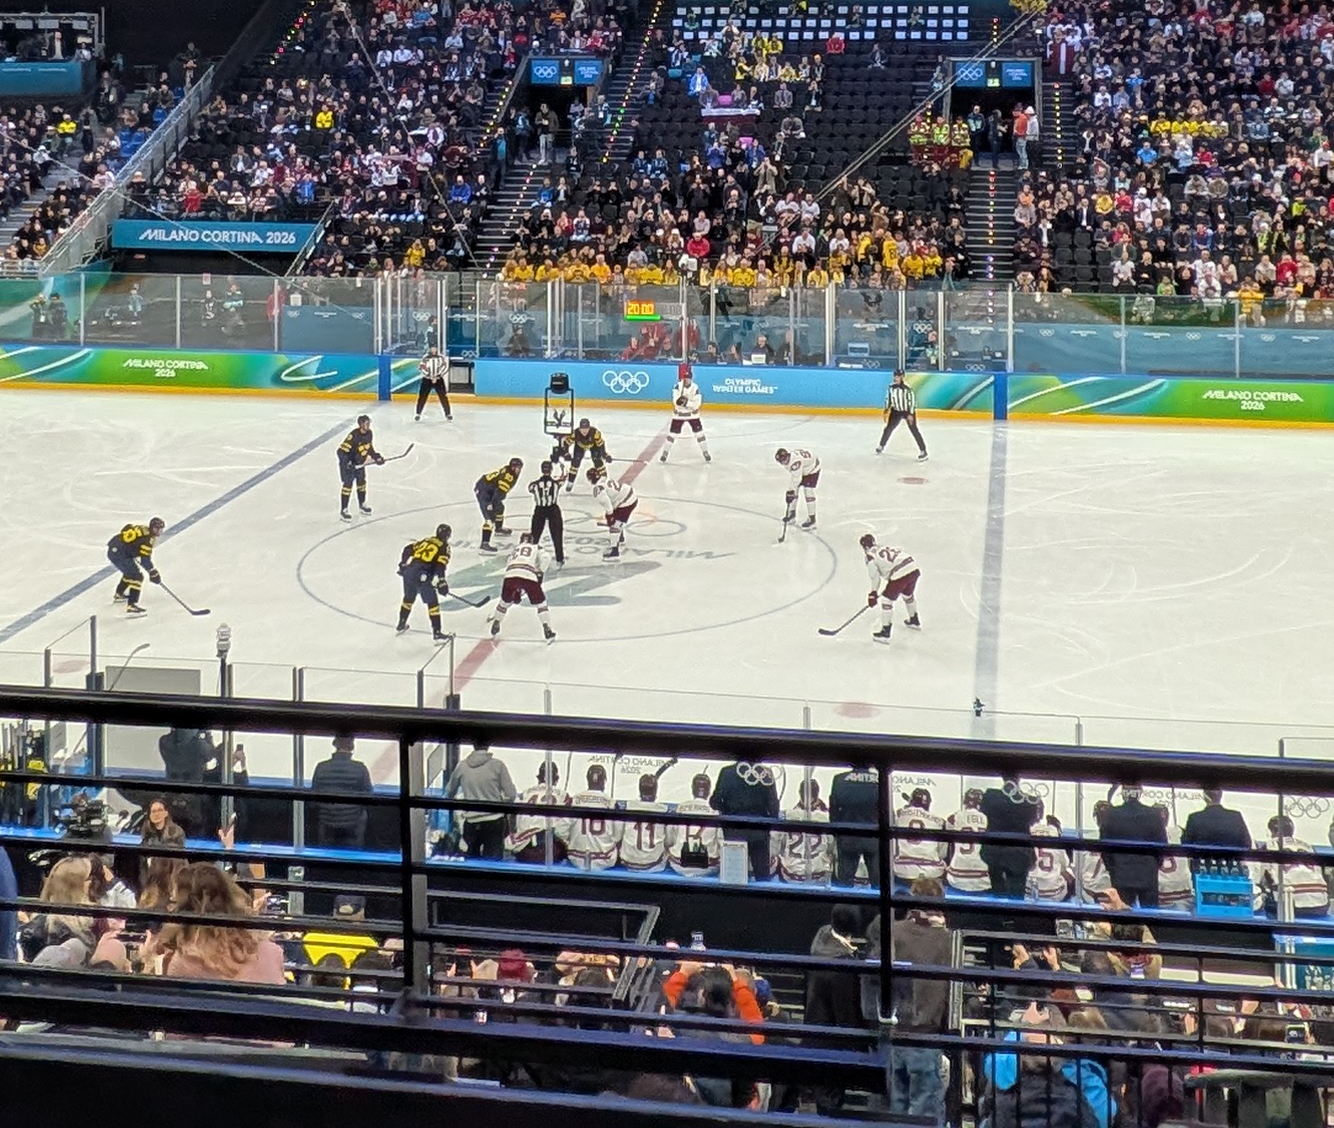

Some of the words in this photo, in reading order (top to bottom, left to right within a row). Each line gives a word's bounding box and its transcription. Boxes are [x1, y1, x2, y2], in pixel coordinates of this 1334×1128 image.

[139, 229, 199, 241] MILANO
[201, 230, 264, 244] CORTINA
[266, 231, 296, 244] 2026
[122, 358, 165, 369] MILANO
[165, 359, 209, 370] CORTINA
[1202, 390, 1252, 401] MILANO
[1253, 391, 1304, 402] CORTINA
[1240, 400, 1266, 411] 2026
[414, 541, 439, 562] 23
